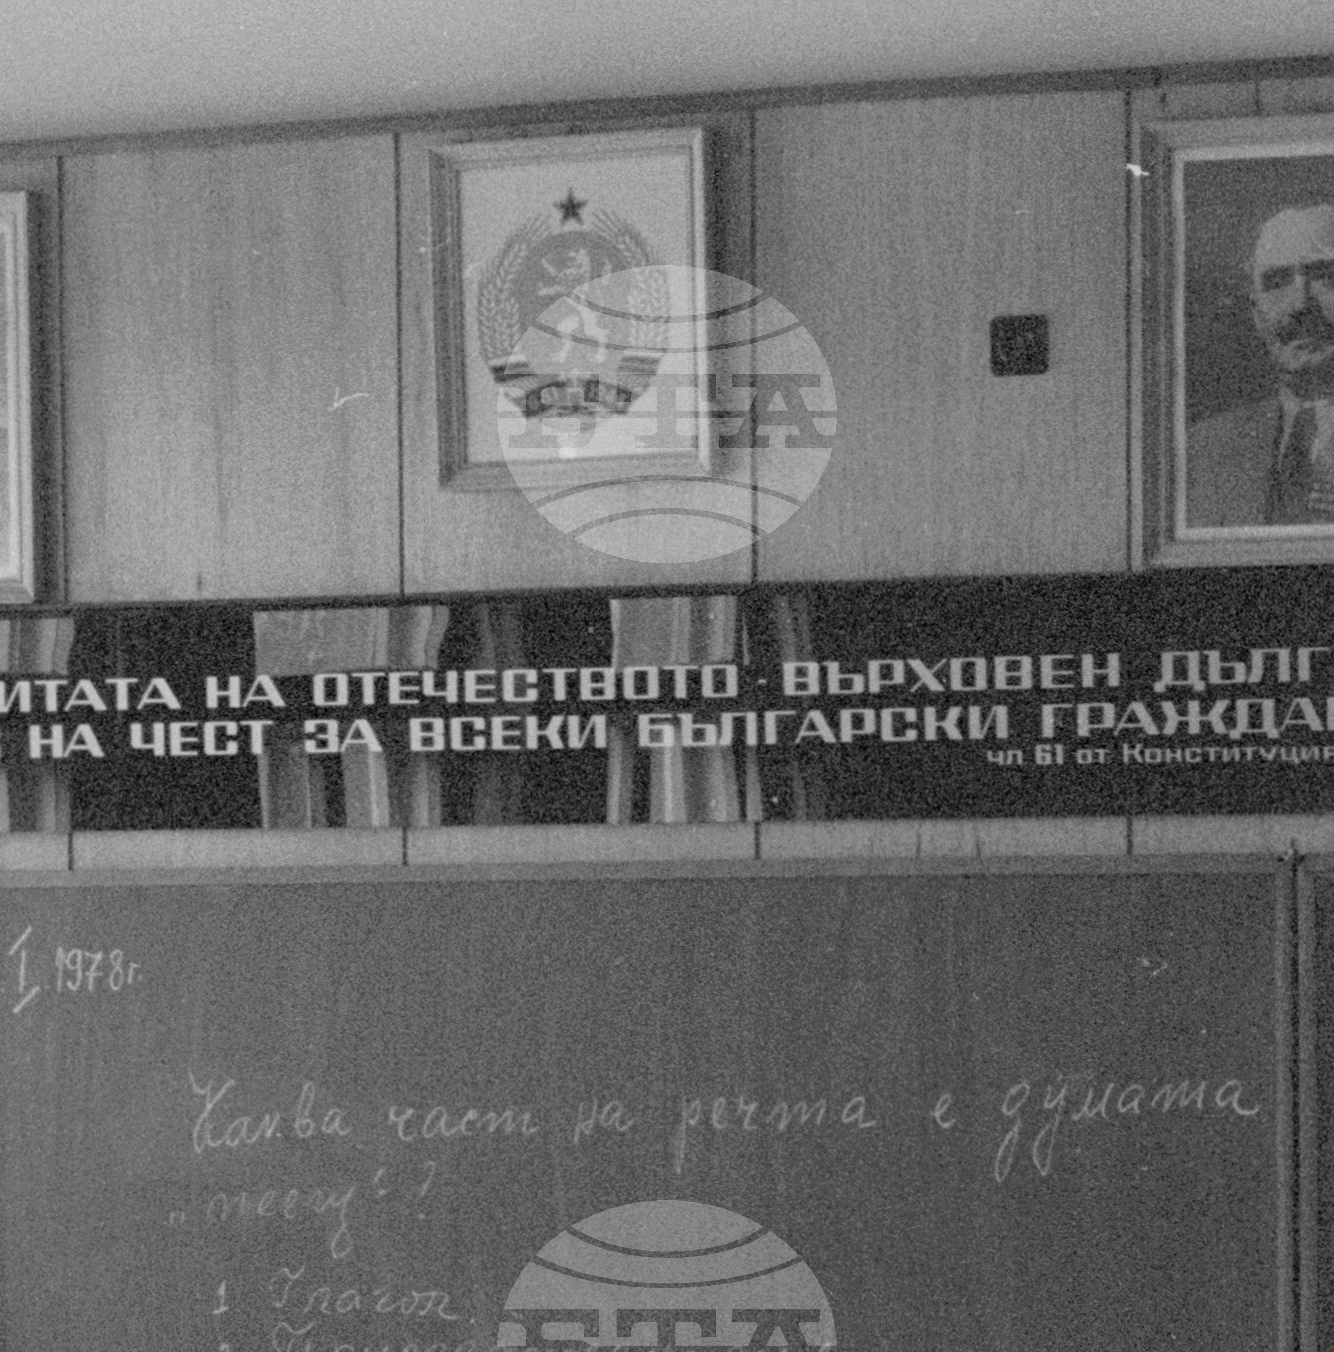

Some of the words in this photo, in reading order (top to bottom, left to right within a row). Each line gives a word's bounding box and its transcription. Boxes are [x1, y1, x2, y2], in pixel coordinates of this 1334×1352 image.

[204, 674, 286, 708] НА
[312, 663, 738, 707] ОТЕЧЕСТВОТО
[782, 652, 1121, 696] ВЪРХОВЕН
[1153, 645, 1331, 693] ДЪЛГ
[28, 722, 105, 759] НА
[129, 719, 274, 757] ЧЕСТ
[303, 717, 383, 755] ЗА
[409, 713, 607, 752] ВСЕКИ
[638, 703, 1009, 748] БЪЛГАРСКИ
[1034, 743, 1064, 765] 61
[187, 1069, 351, 1155] Каква
[930, 1090, 958, 1131] е
[993, 1077, 1262, 1184] думата
